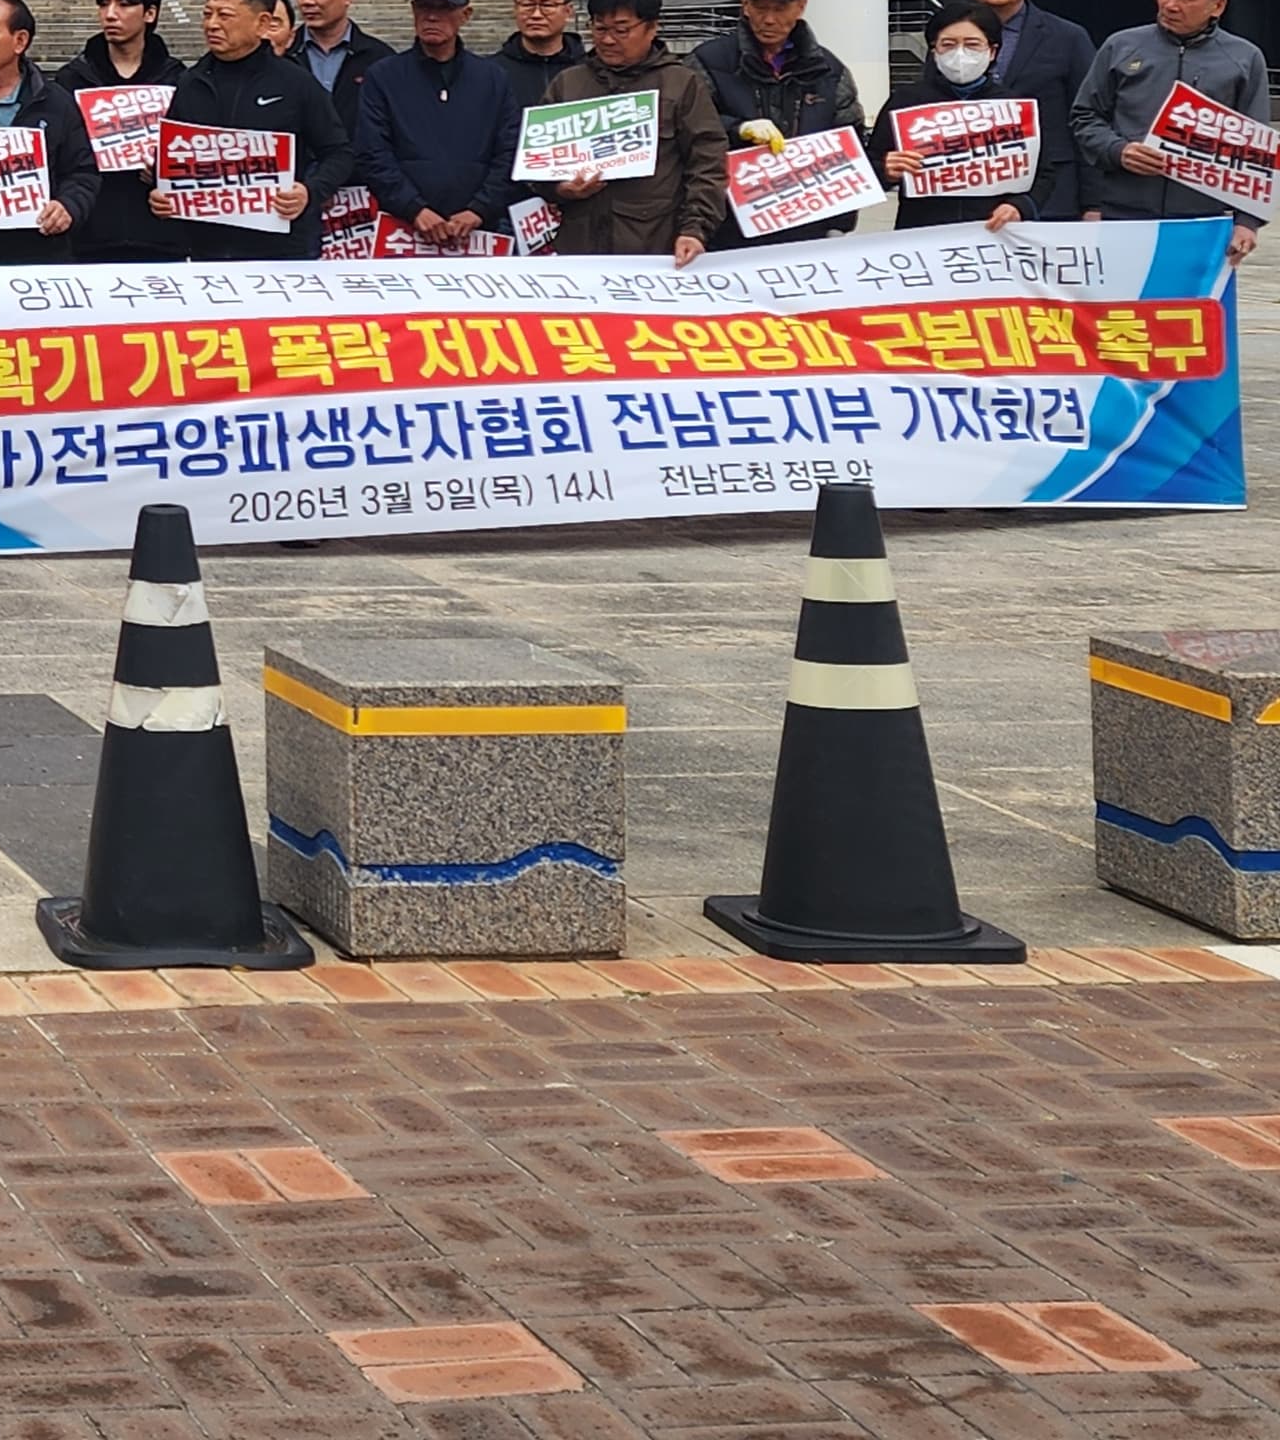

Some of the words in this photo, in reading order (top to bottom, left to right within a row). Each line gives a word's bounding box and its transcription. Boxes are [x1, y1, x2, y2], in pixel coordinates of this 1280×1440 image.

[527, 97, 652, 147] 양파가격은
[590, 124, 652, 160] 결정!
[908, 101, 1022, 141] 수입양파
[1168, 102, 1280, 152] 수입양파
[167, 132, 278, 163] 수입양파
[523, 143, 591, 170] 농민이
[736, 132, 843, 186] 수입양파
[913, 153, 1029, 195] 마련하라!
[164, 187, 280, 217] 마련하라
[750, 171, 872, 232] 마련하라!
[11, 276, 93, 312] 양파
[108, 274, 187, 309] 수확
[201, 272, 244, 306] 전
[252, 270, 328, 303] 각격
[341, 270, 417, 301] 폭락
[430, 271, 598, 302] 막아내고,
[600, 272, 751, 304] 살인적인
[763, 263, 844, 296] 민간
[854, 254, 934, 288] 수입
[942, 248, 1106, 287] 중단하라!
[128, 328, 249, 399] 가격
[269, 320, 392, 383] 폭락
[414, 319, 537, 380] 저지
[550, 315, 616, 377] 및
[628, 314, 858, 373] 수입양파
[870, 307, 1085, 368] 근본대책
[1097, 308, 1206, 372] 촉구
[612, 386, 881, 451] 전남도지부
[900, 386, 1088, 449] 기자회견
[230, 488, 350, 524] 2026년
[362, 483, 412, 516] 3월
[425, 472, 534, 514] 5일(목)
[546, 469, 614, 505] 14시
[659, 464, 776, 496] 전남도청
